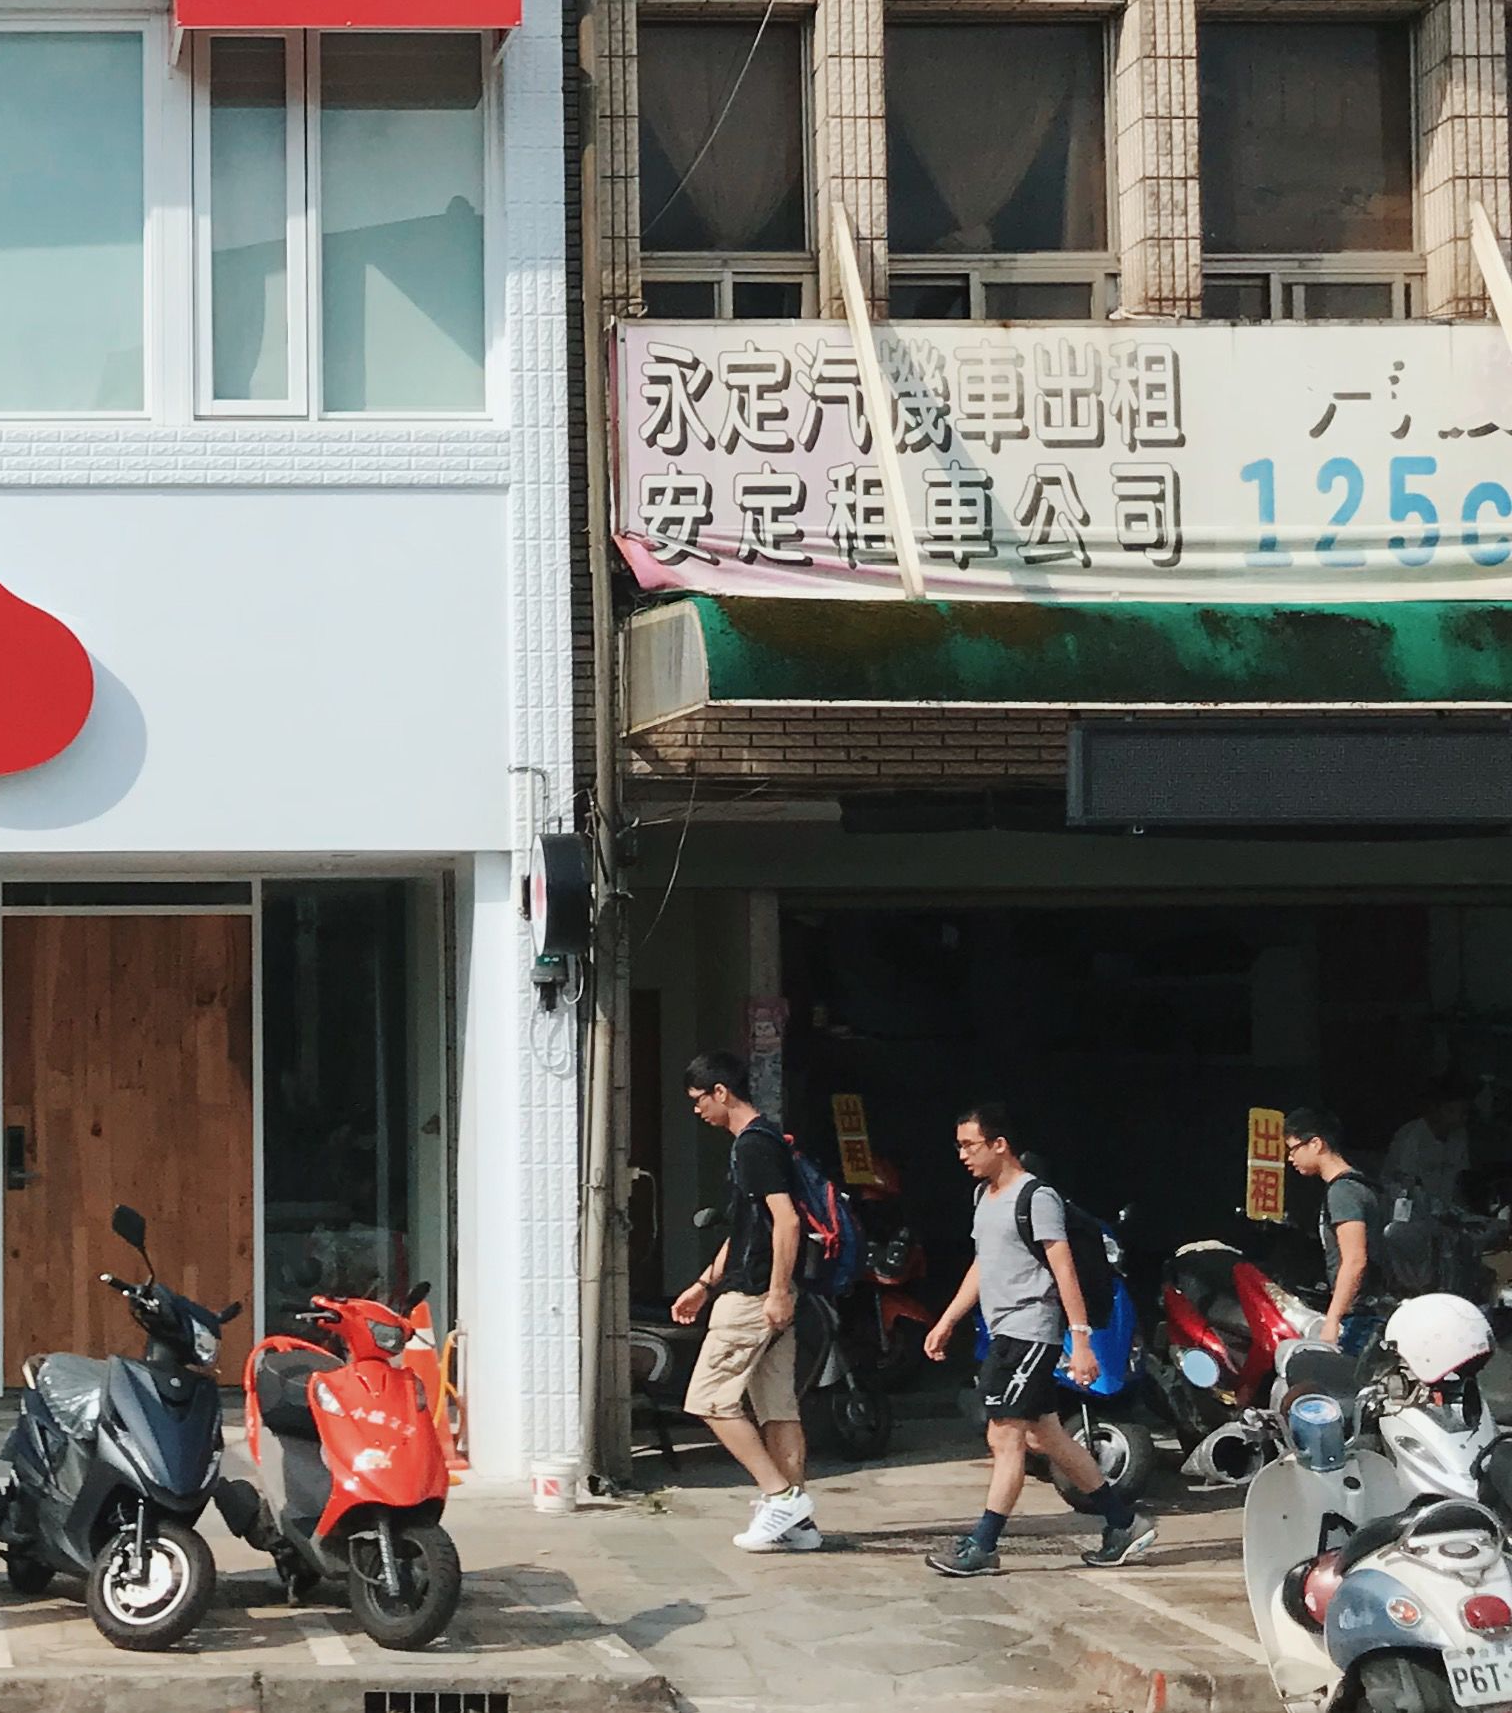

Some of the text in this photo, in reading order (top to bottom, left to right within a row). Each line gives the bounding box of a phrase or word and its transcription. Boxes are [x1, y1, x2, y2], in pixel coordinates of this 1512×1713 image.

[638, 460, 1184, 569] 安定租車公司
[1251, 1118, 1281, 1213] 出租
[1452, 1662, 1512, 1696] P6T-
